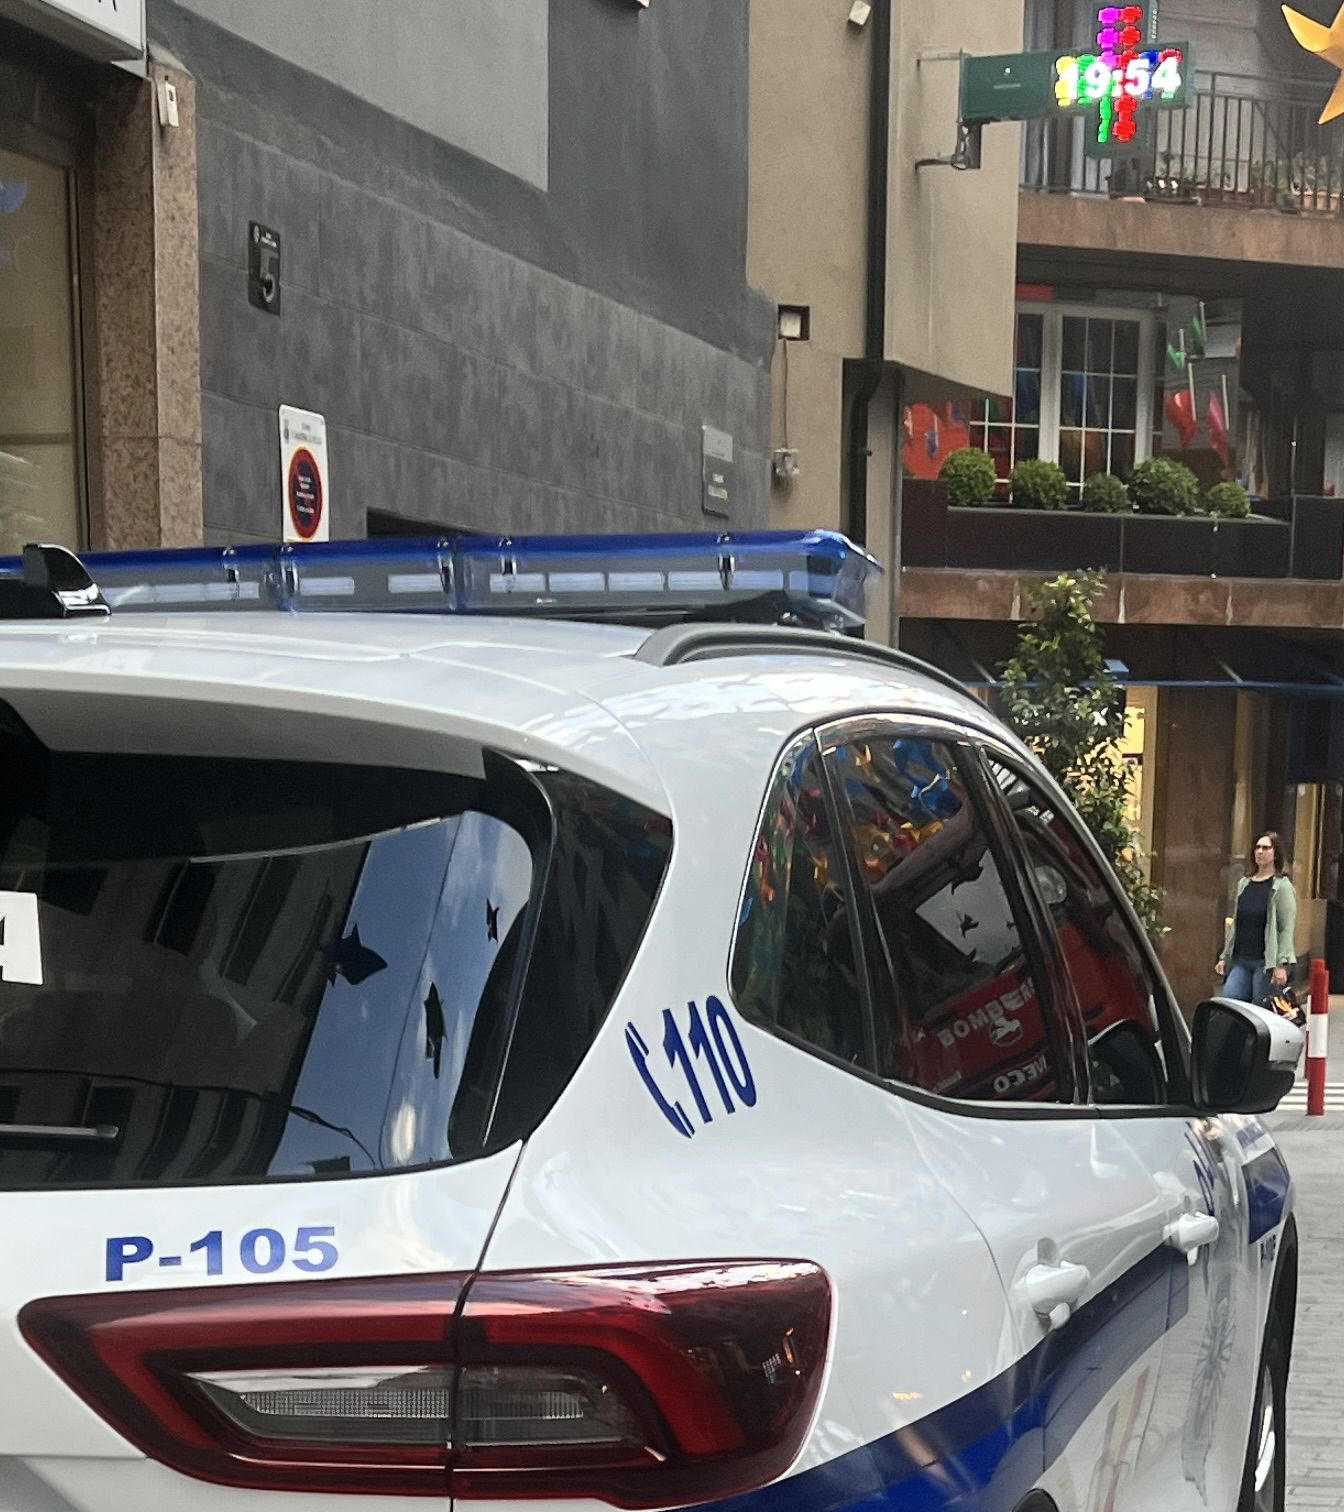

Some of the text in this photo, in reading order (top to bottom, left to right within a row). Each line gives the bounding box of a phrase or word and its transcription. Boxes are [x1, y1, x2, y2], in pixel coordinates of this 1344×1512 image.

[1059, 56, 1182, 99] 19:54
[259, 250, 278, 304] 5
[662, 995, 758, 1124] 110
[105, 1226, 339, 1283] P-105
